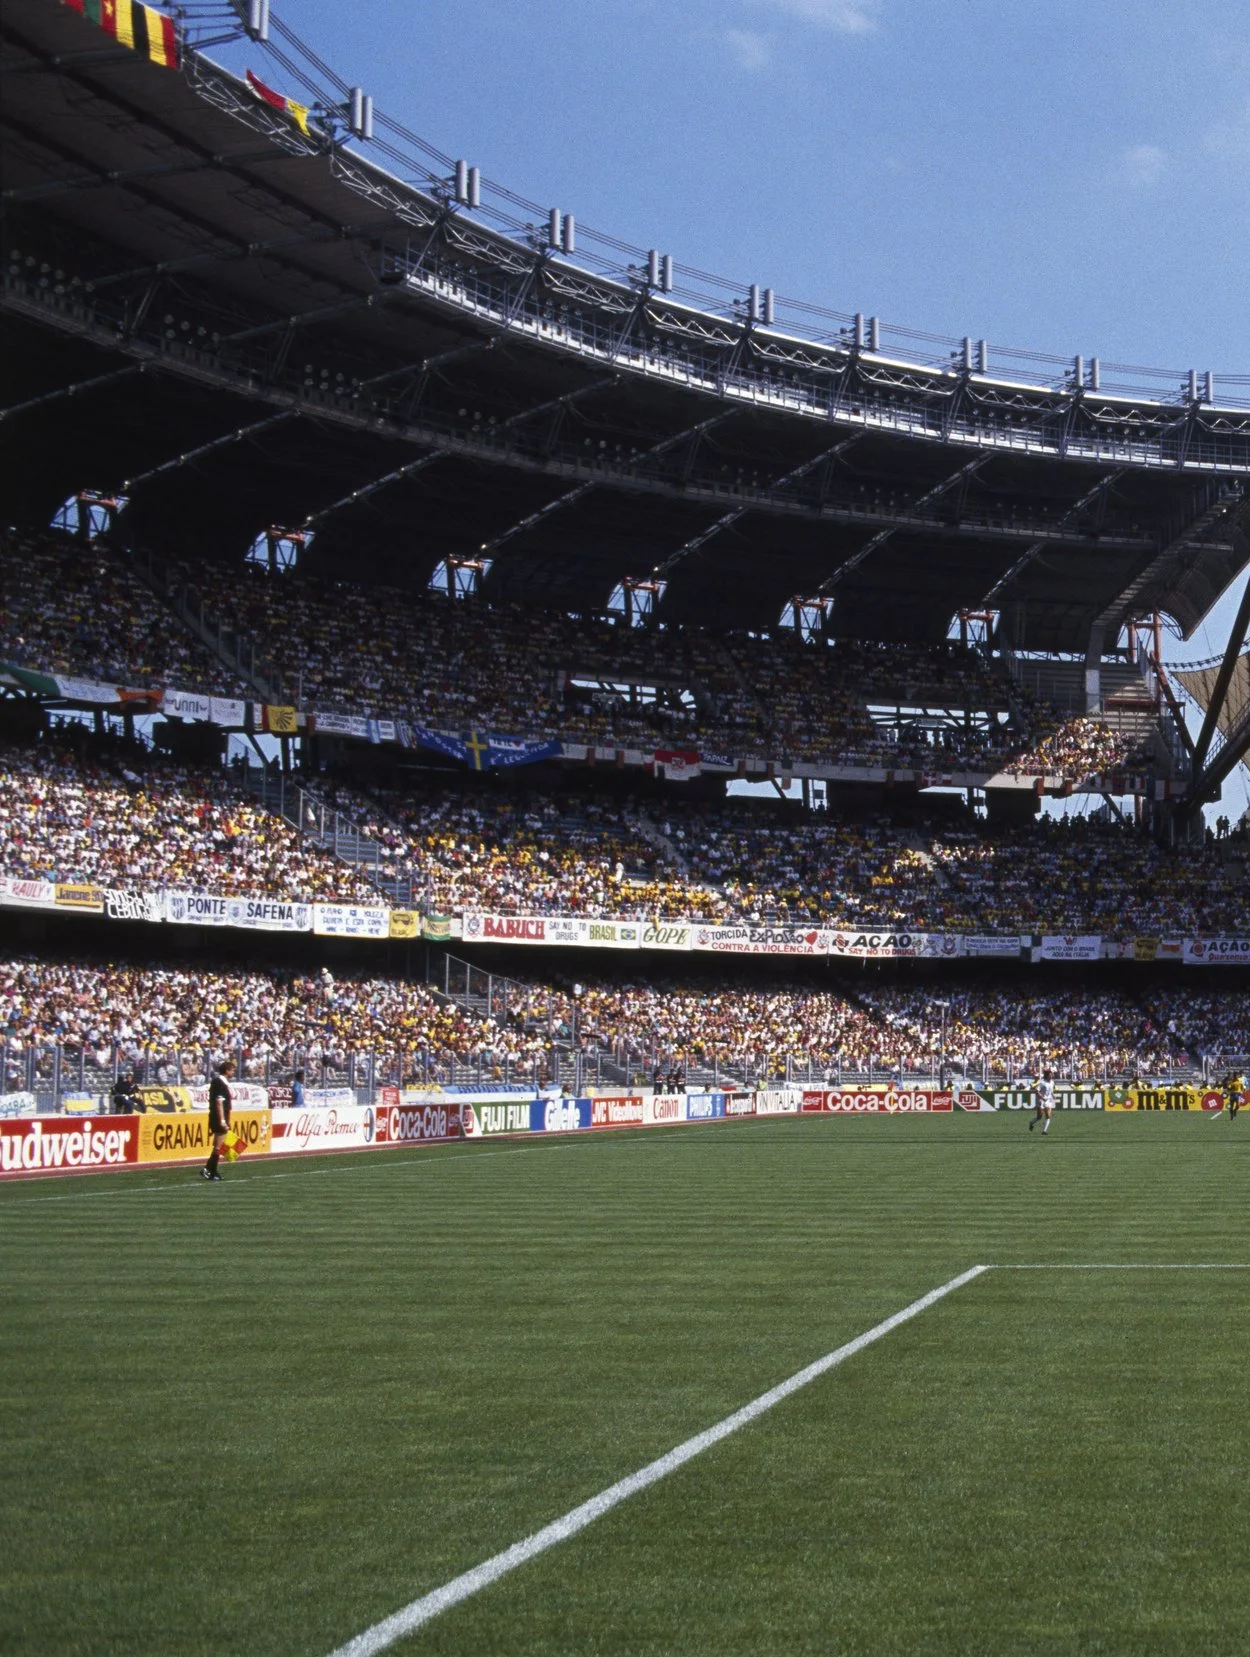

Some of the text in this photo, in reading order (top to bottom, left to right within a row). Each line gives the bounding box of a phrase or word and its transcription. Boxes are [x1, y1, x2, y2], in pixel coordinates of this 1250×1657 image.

[187, 897, 294, 920] PONTE SAFENA
[483, 917, 546, 940] BABUCH
[549, 920, 561, 931] SAY
[579, 922, 587, 931] TO
[556, 931, 579, 941] DRUGS
[589, 924, 618, 941] BRASIL
[711, 929, 748, 941] TORCIDA
[712, 942, 751, 952] CONTRA
[753, 944, 760, 952] A
[848, 947, 863, 955] SAY
[892, 948, 916, 956] DRUGS
[1208, 940, 1250, 953] AÇÃO
[653, 1097, 679, 1120] Canon
[826, 1091, 928, 1111] Coca-Cola
[993, 1092, 1102, 1109] FUJ FILM
[389, 1106, 447, 1141] Coca-Cola
[480, 1103, 531, 1132] FUJI FILM
[544, 1099, 581, 1131] Gillette
[153, 1118, 259, 1151] GRANA PANO
[295, 1109, 358, 1148] Alfa Romeo
[0, 1121, 131, 1171] udweiser
